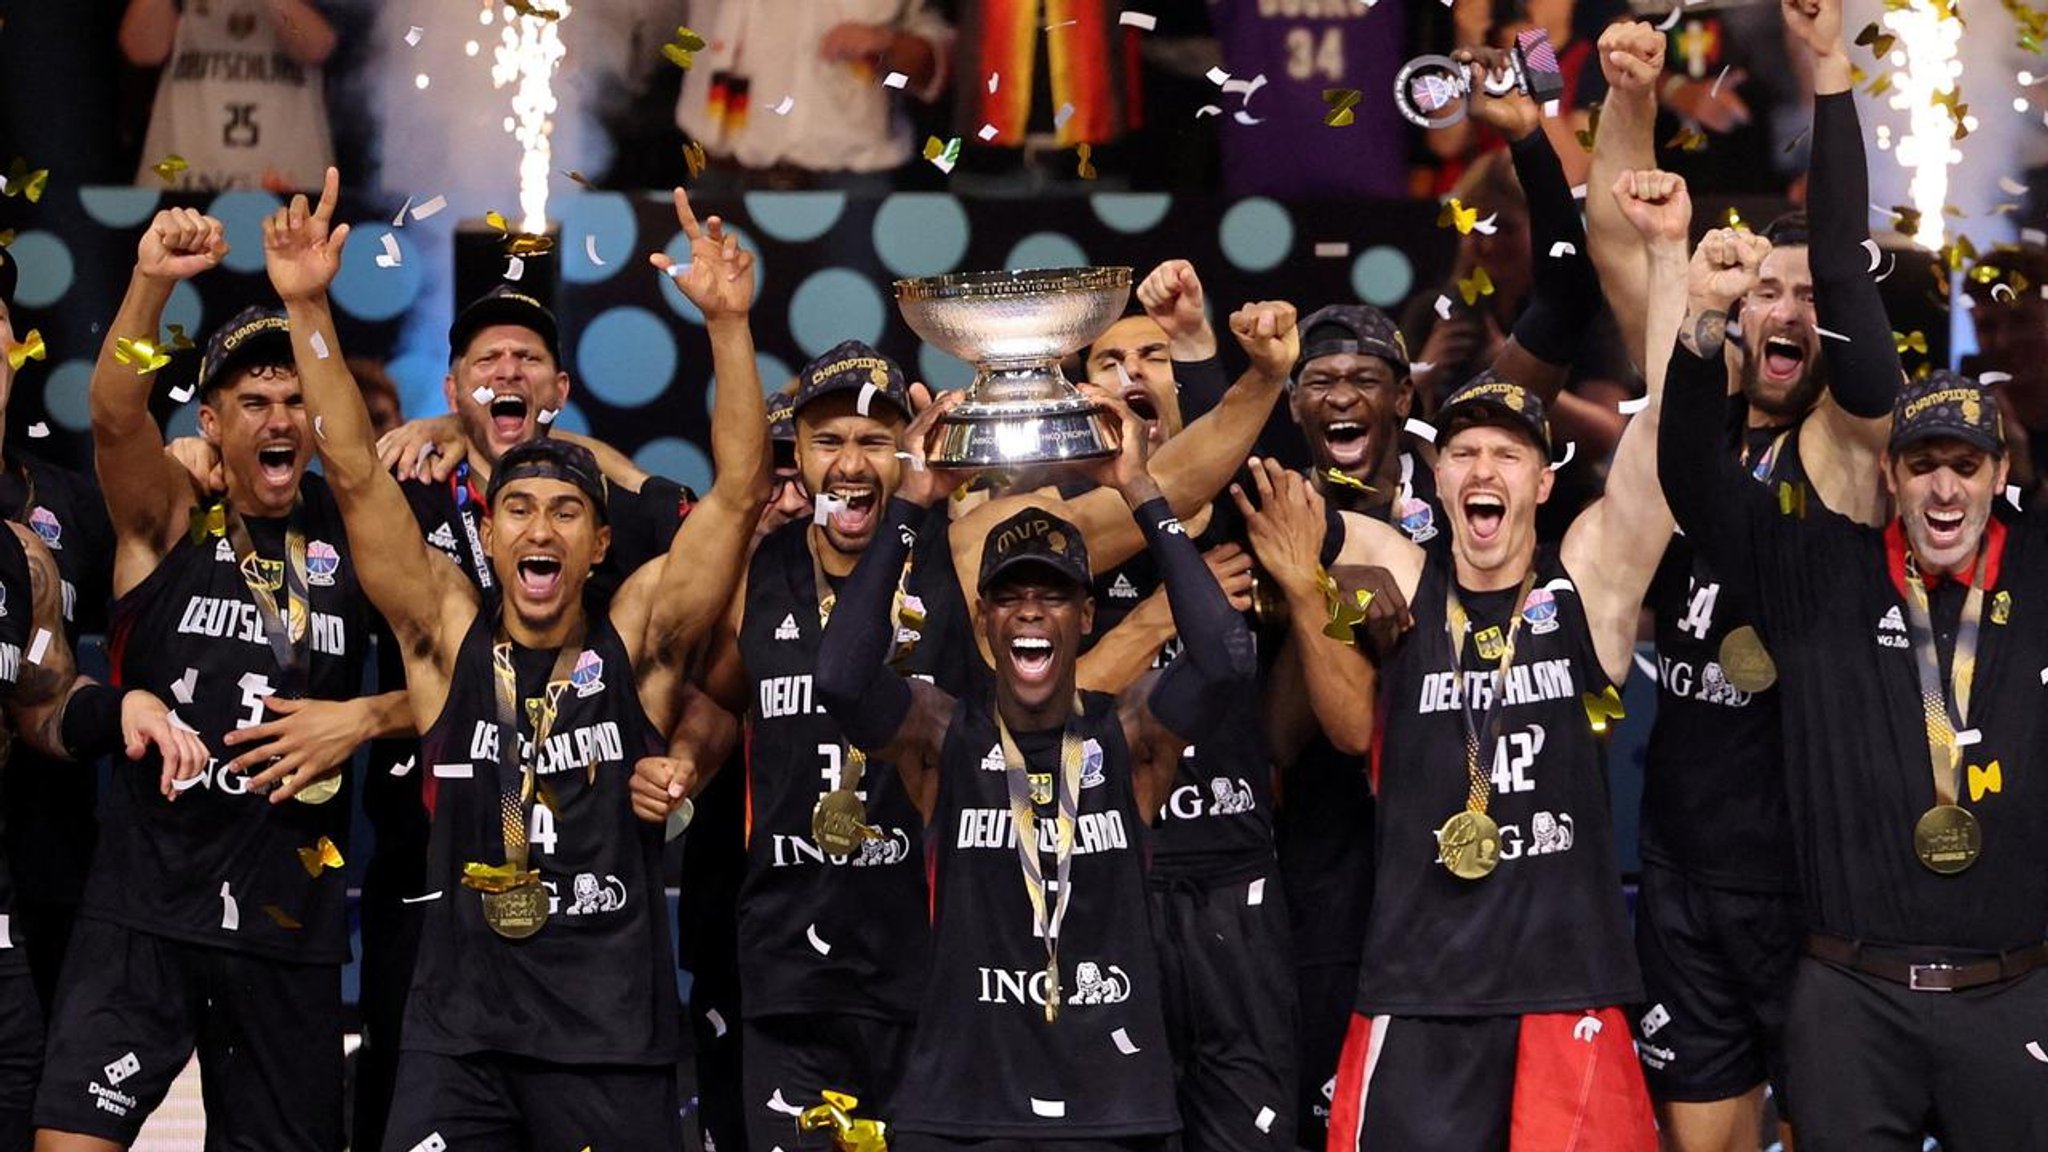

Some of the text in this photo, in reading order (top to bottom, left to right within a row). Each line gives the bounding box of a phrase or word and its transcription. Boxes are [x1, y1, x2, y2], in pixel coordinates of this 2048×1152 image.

[1286, 27, 1344, 80] 34
[222, 102, 260, 148] 25
[223, 316, 290, 350] CHAMPIO
[811, 356, 889, 386] CHAMPIONS
[1904, 388, 1981, 420] CHAMPIONS
[997, 519, 1050, 554] MVP
[1491, 732, 1536, 794] 42
